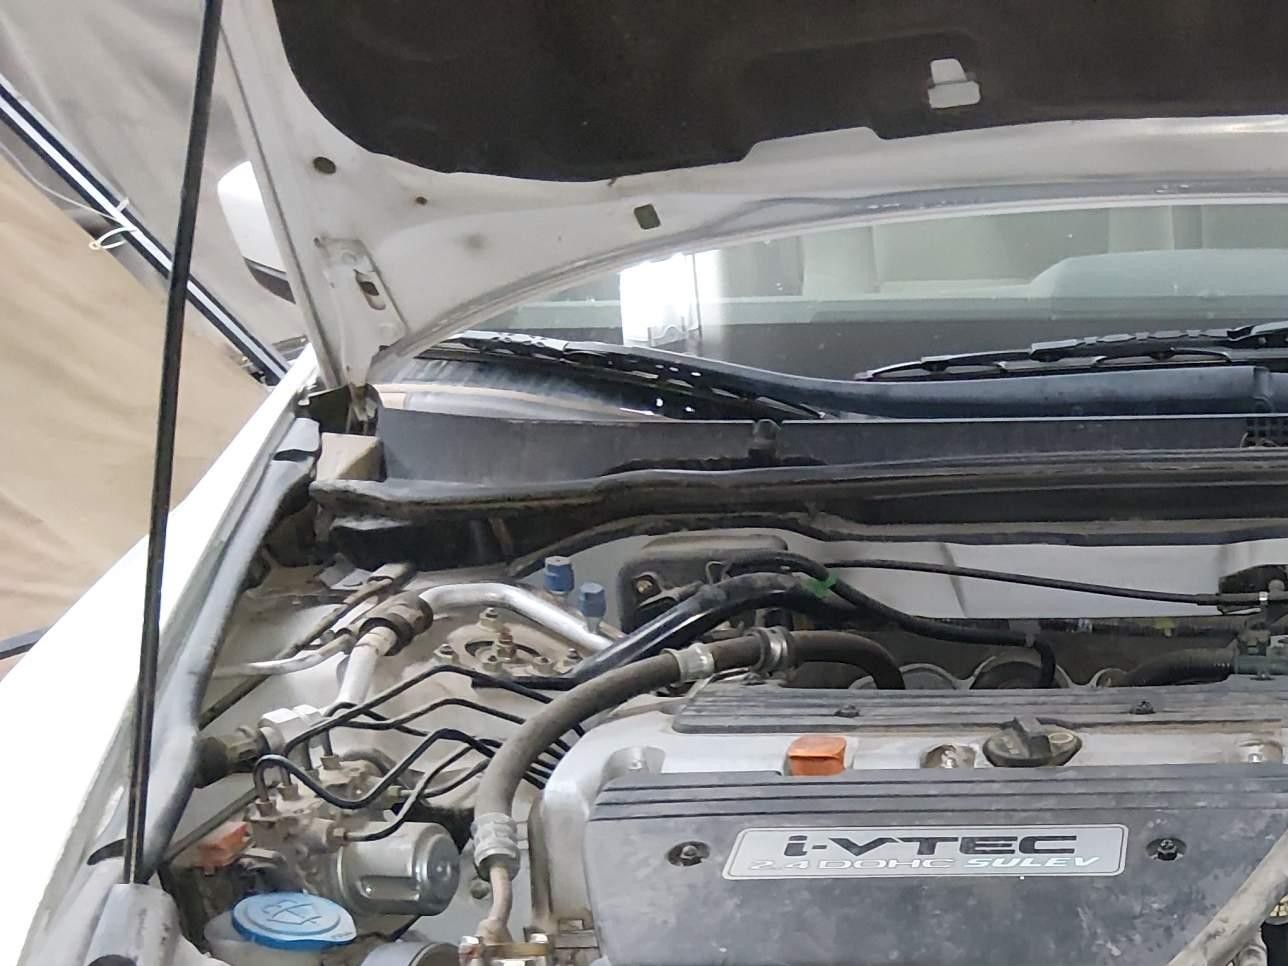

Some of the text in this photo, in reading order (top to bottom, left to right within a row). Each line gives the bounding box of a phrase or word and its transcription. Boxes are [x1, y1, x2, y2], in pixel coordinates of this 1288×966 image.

[783, 834, 1078, 857] i-VTEC
[817, 858, 955, 869] DOHC
[963, 856, 1100, 868] SULEV
